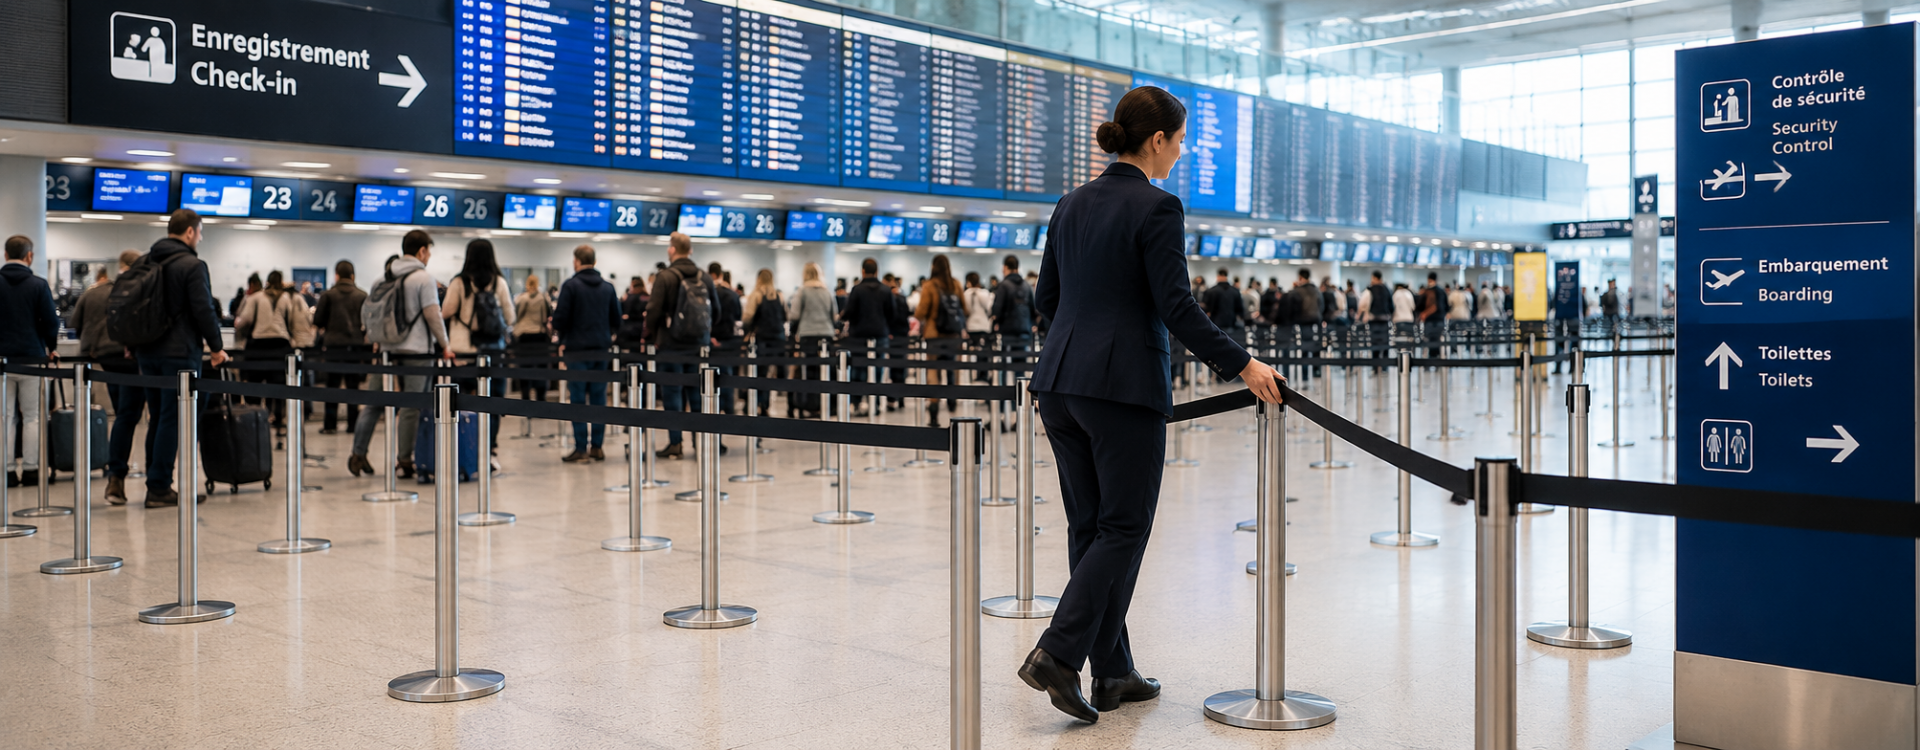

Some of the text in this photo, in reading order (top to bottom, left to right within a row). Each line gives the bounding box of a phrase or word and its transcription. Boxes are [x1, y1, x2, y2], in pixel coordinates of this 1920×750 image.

[191, 23, 371, 70] Enregistrement
[190, 60, 298, 96] Check-in
[1772, 86, 1866, 108] de sécurité
[1772, 118, 1838, 136] Security
[1772, 137, 1833, 155] Control
[263, 186, 292, 210] 23
[311, 189, 338, 212] 24
[423, 195, 449, 218] 26
[463, 198, 488, 220] 26
[1758, 257, 1889, 275] Embarquement
[1758, 287, 1833, 304] Boarding
[1758, 346, 1832, 361] Toilettes
[1758, 373, 1813, 388] Toilets
